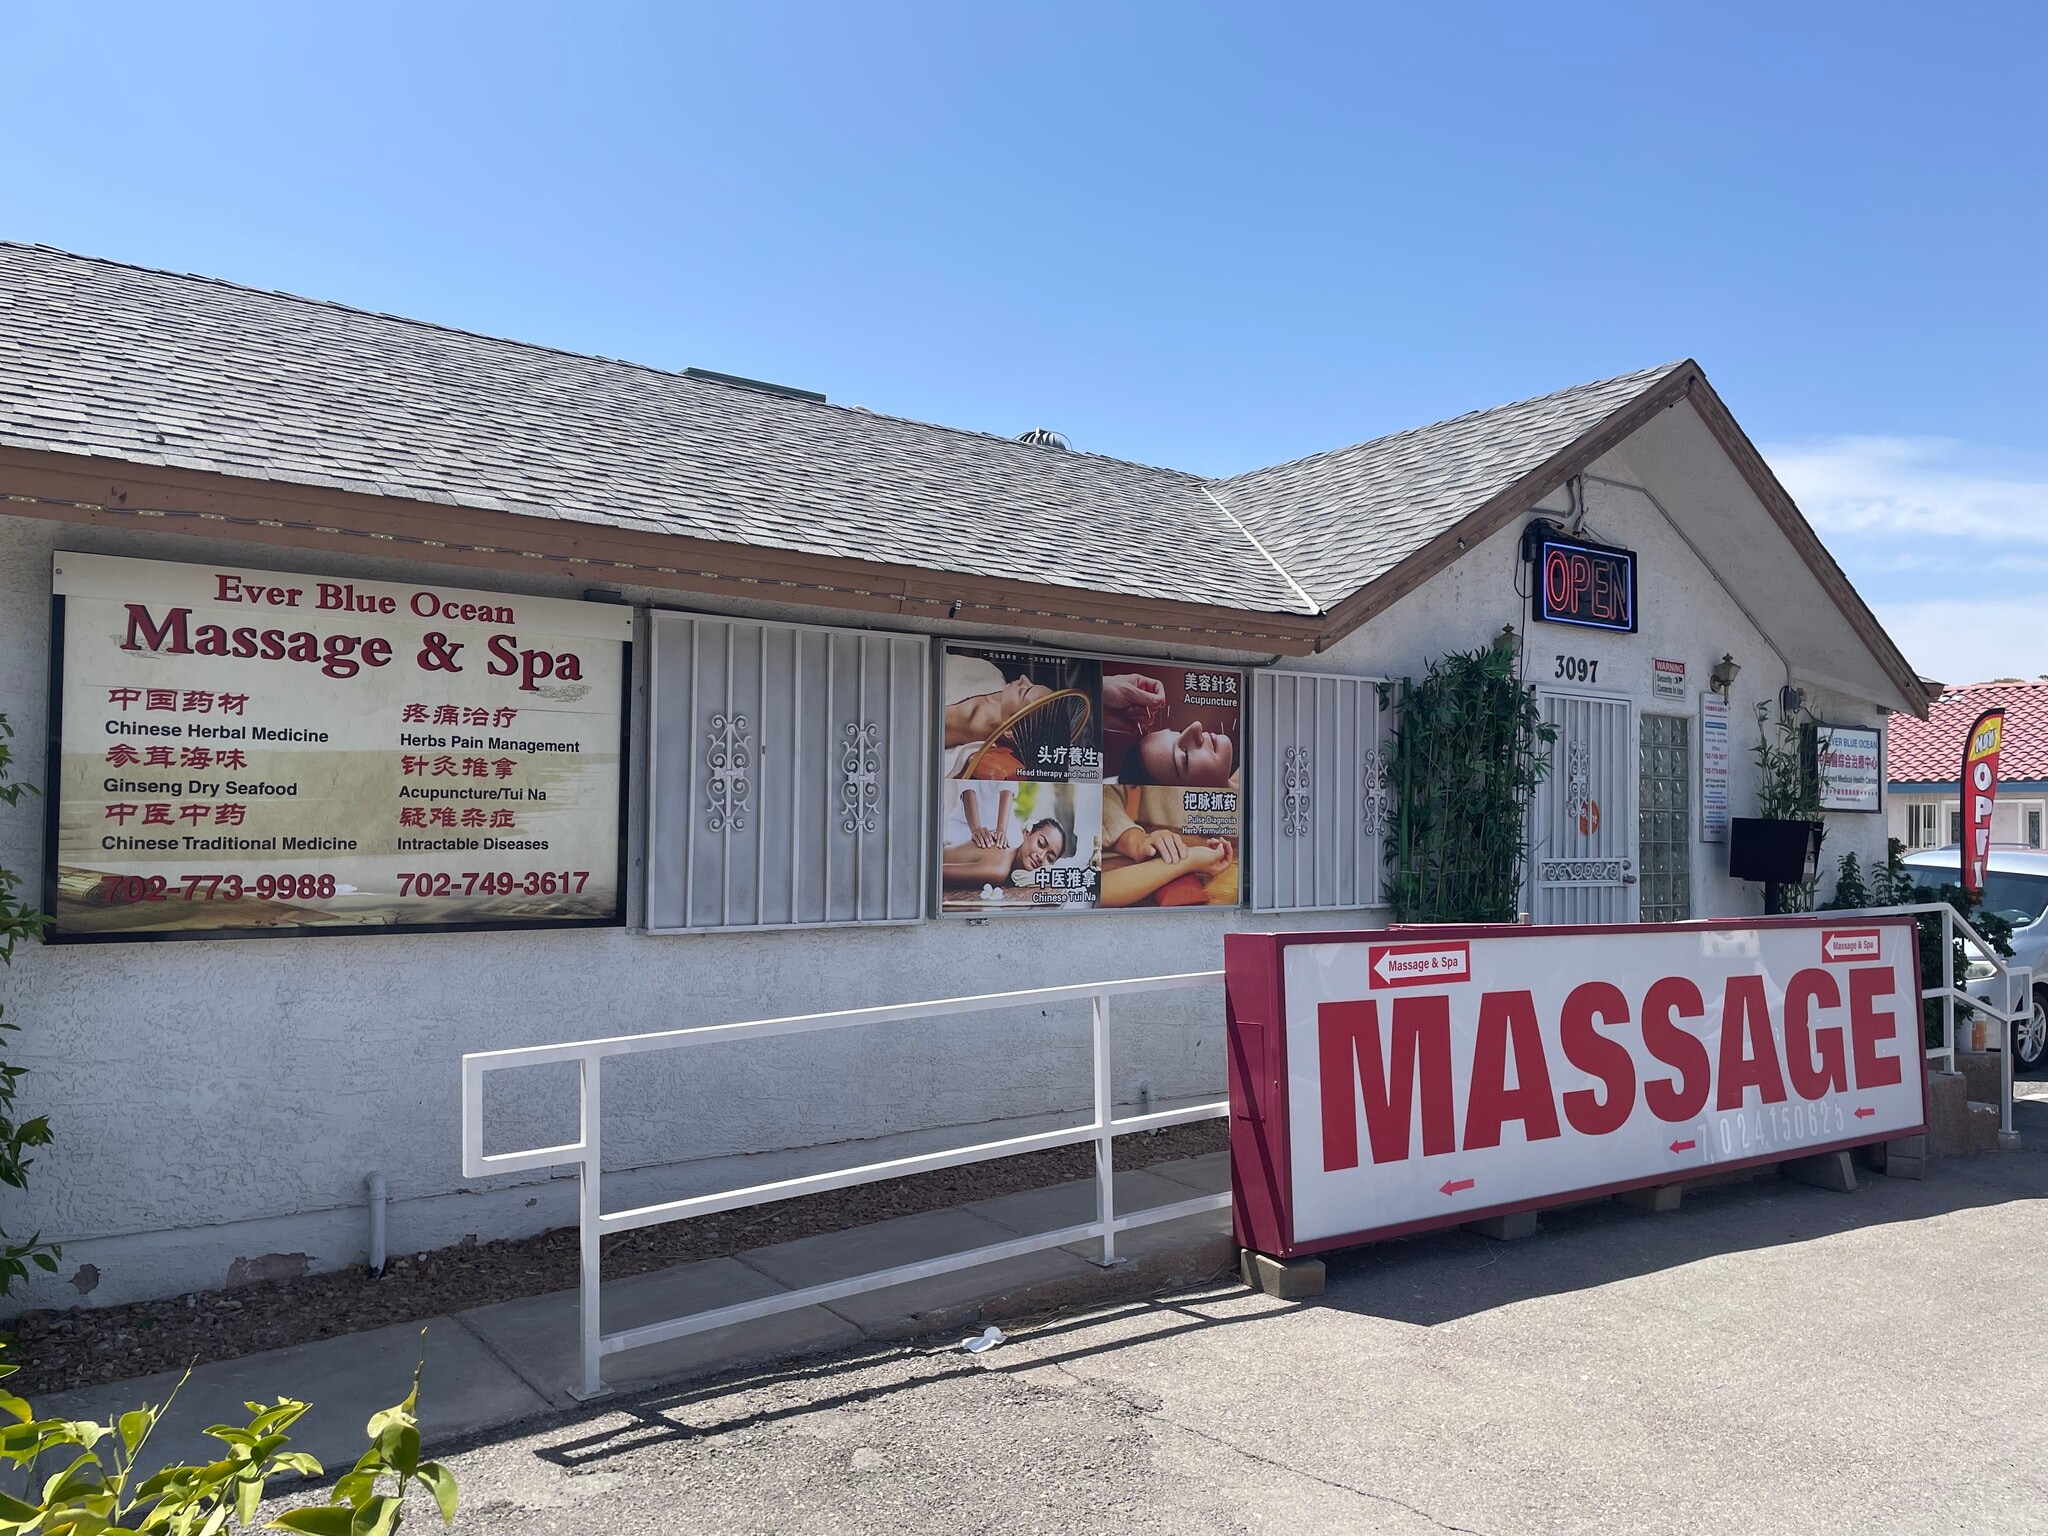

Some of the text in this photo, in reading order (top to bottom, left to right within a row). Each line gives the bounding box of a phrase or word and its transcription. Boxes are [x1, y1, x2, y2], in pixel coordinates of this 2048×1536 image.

[1546, 550, 1629, 621] OPEN
[213, 574, 515, 624] Ever Blue Ocean
[119, 603, 583, 691] Massage & Spa
[1554, 654, 1599, 683] 3097
[1656, 660, 1684, 674] WARNING
[1184, 672, 1237, 694] 美容針灸
[108, 687, 250, 716] 中国药材
[1184, 693, 1238, 707] Acupuncture
[402, 703, 518, 728] 疼痛治疗
[105, 720, 329, 743] Chinese Herbal Medicine
[400, 733, 580, 754] Herbs Pain Management
[1844, 738, 1858, 748] BLUE
[1859, 739, 1878, 750] OCEAN
[105, 743, 248, 771] 参茸海味
[1037, 745, 1098, 766] 头疗養生
[400, 755, 518, 779] 针灸推拿
[1017, 768, 1099, 778] Head therapy and health
[103, 777, 298, 798] Ginseng Dry Seafood
[399, 785, 546, 801] Acupuncture/Tui Na
[1184, 792, 1237, 811] 把脉抓药
[105, 802, 247, 827] 中医中药
[399, 806, 516, 829] 疑难杂症
[1188, 815, 1237, 826] Pulse Diagnosis
[1182, 826, 1237, 835] Herb Formulation
[101, 836, 357, 850] Chinese Traditional Medicine
[397, 838, 549, 850] Intractable Diseases
[101, 873, 336, 902] 702-773-9988
[397, 871, 590, 898] 702-749-3617
[1035, 868, 1097, 889] 中医推拿
[1033, 892, 1096, 902] Chinese Tui Na
[1832, 940, 1874, 952] Massage & Spa
[1388, 956, 1458, 973] Massage & Spa
[1317, 965, 1902, 1173] MASSAGE
